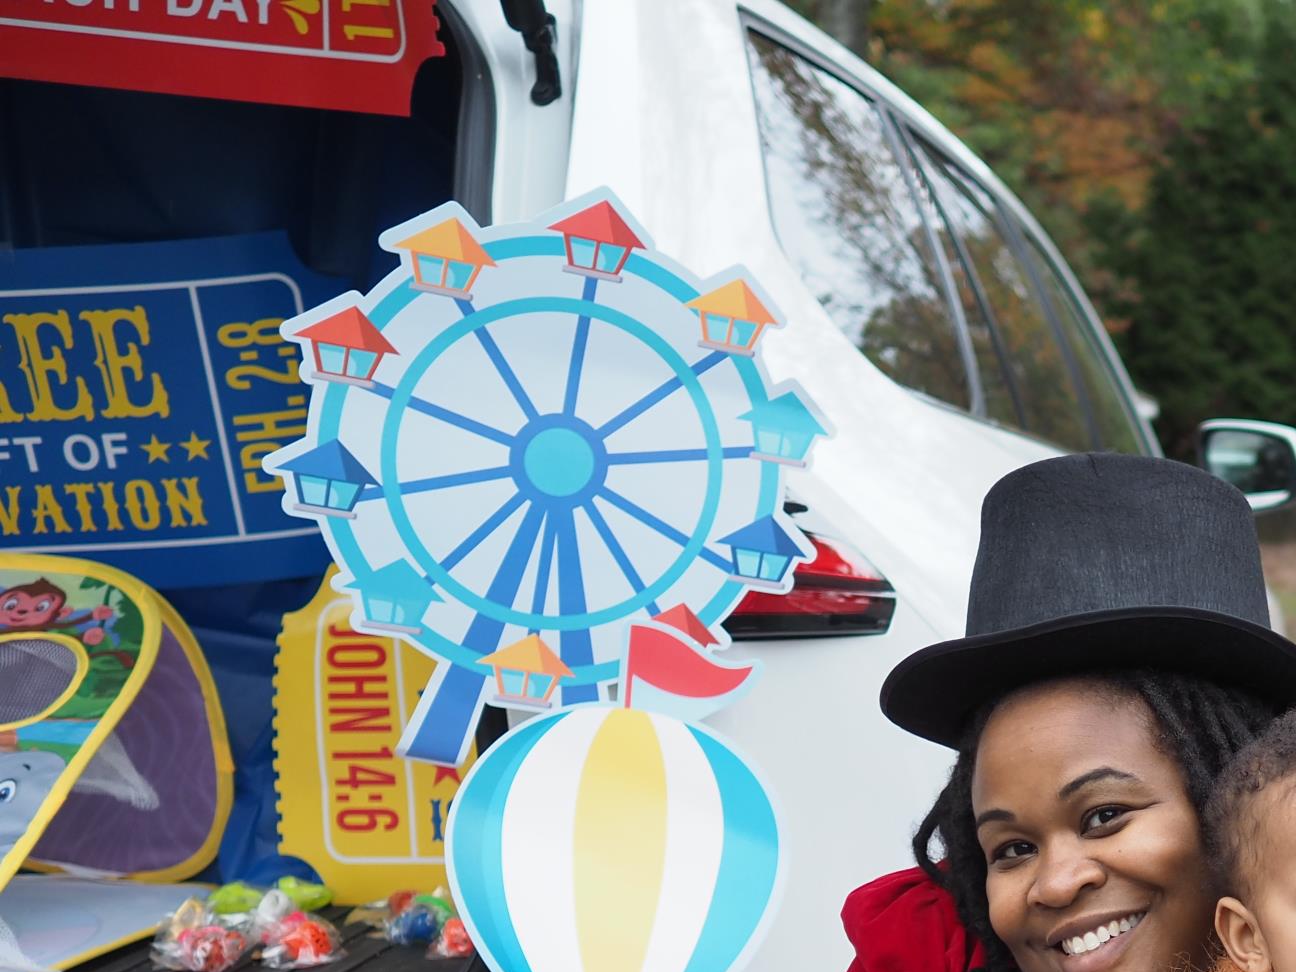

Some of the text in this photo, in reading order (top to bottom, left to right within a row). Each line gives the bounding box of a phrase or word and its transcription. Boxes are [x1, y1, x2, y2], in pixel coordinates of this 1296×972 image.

[0, 304, 170, 423] EE
[217, 317, 300, 391] 2:8
[63, 432, 129, 472] OF
[327, 625, 399, 832] JOHN 14:6
